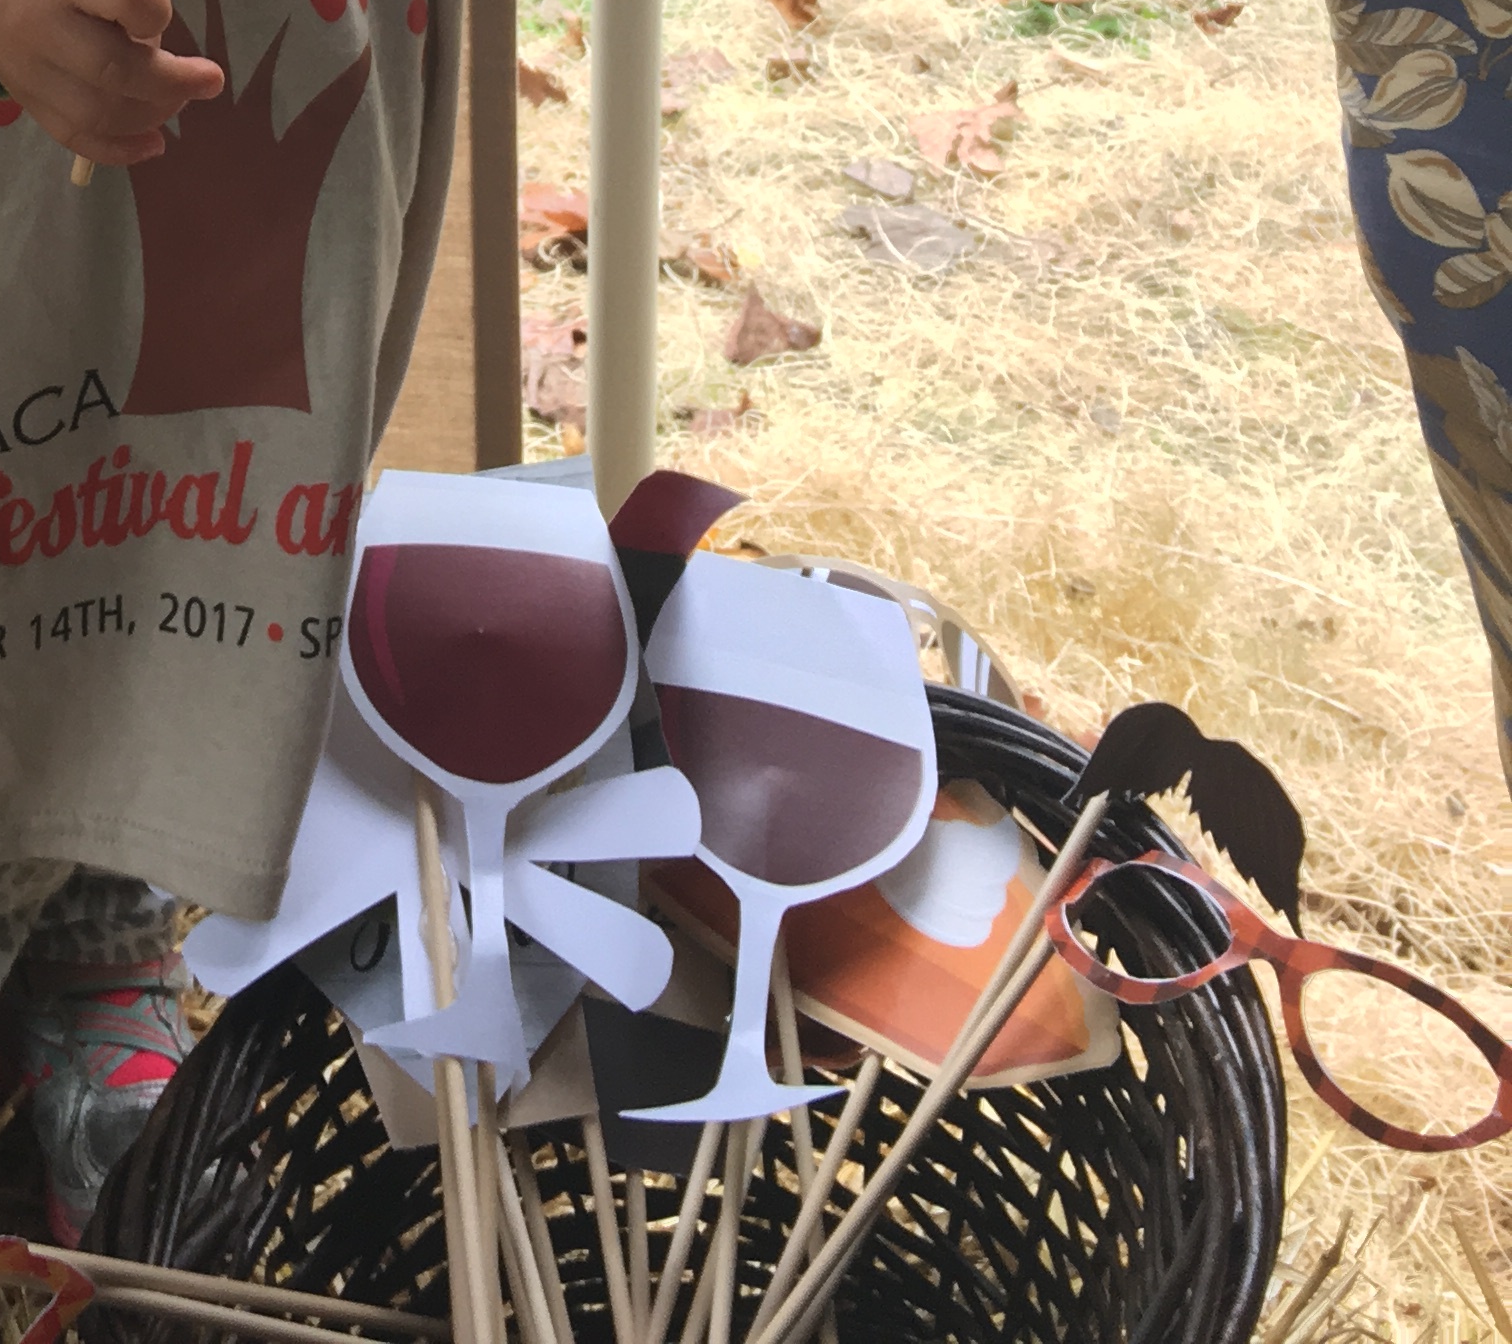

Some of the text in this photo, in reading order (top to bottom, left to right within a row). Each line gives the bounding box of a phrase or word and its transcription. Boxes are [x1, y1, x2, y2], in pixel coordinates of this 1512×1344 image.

[29, 593, 136, 651] 14TH,
[158, 592, 255, 647] 2017
[299, 615, 343, 660] SP
